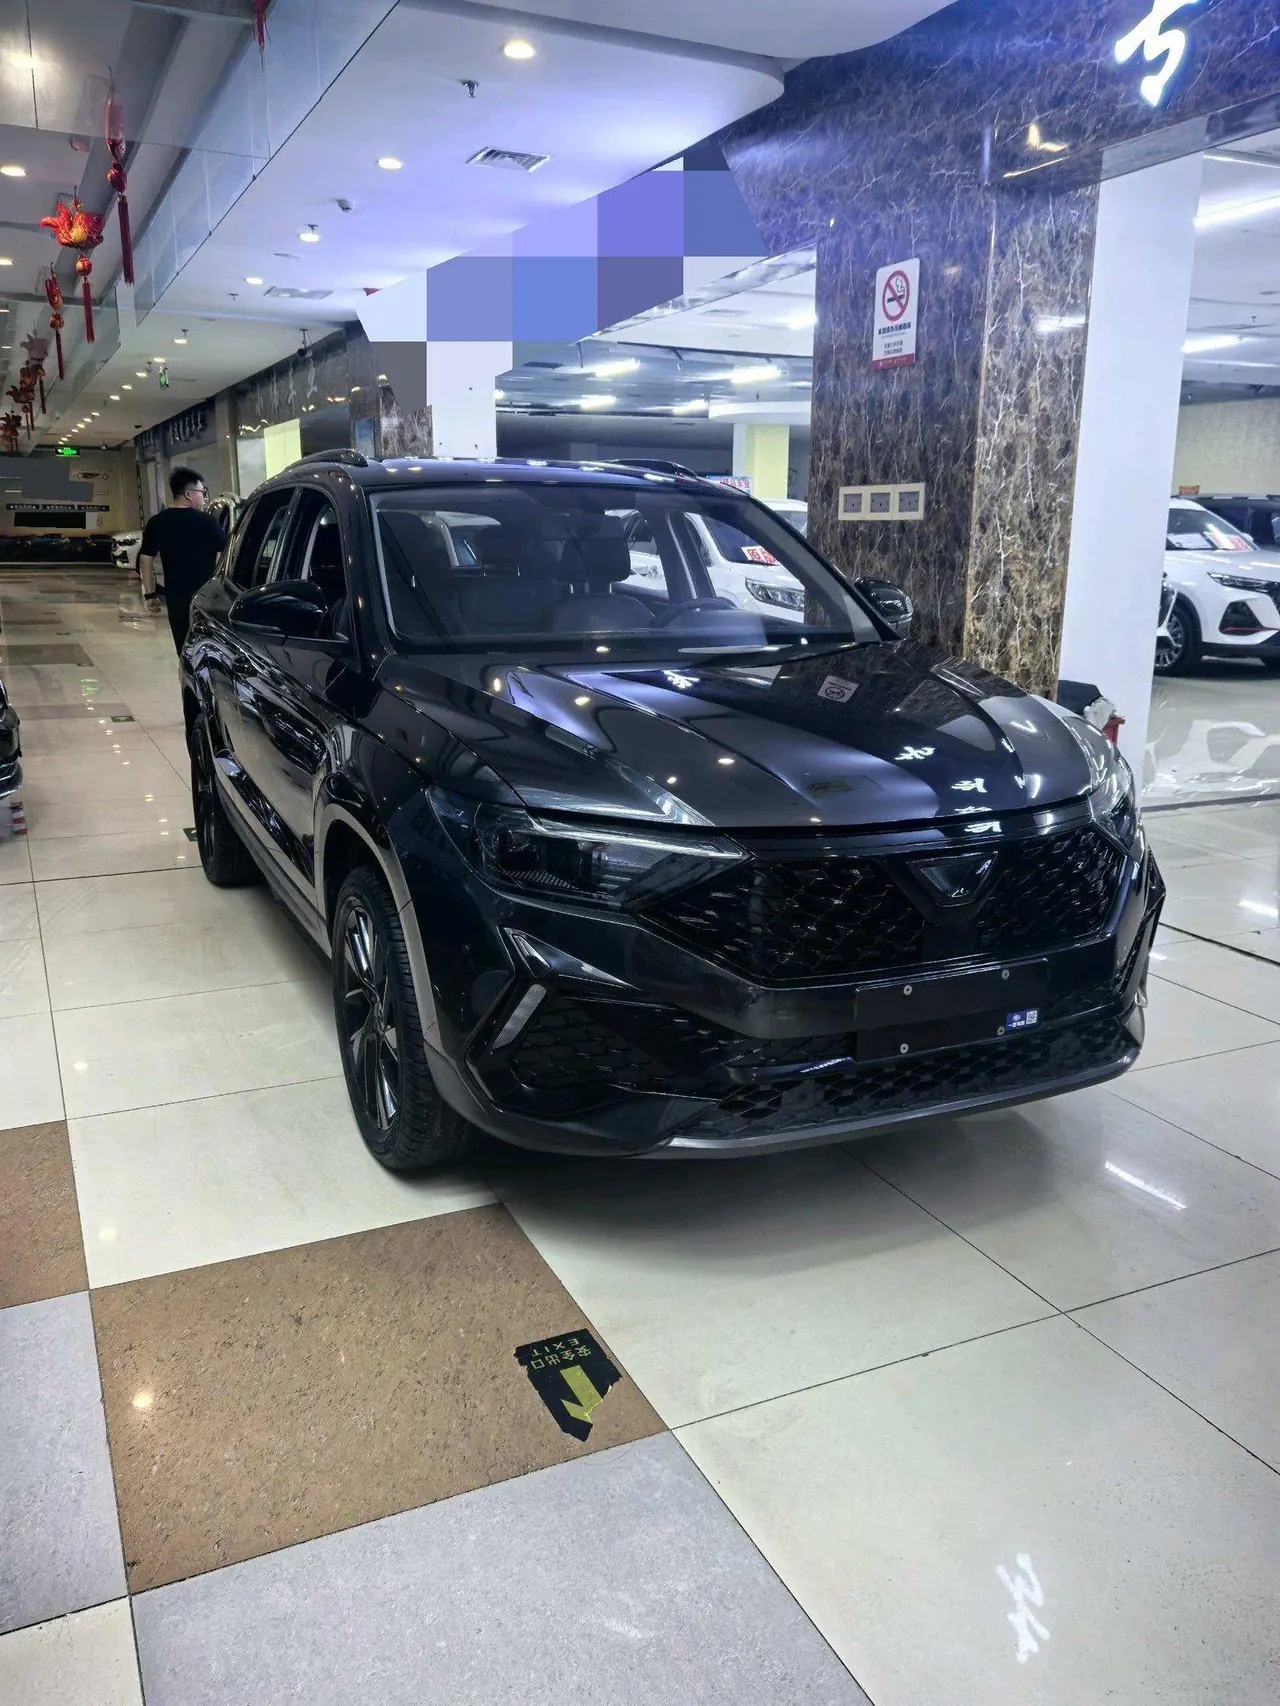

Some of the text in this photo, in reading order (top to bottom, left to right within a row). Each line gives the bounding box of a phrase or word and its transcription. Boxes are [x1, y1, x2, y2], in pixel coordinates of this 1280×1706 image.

[530, 1345, 592, 1370] 安全出口
[531, 1338, 580, 1357] EXIT
